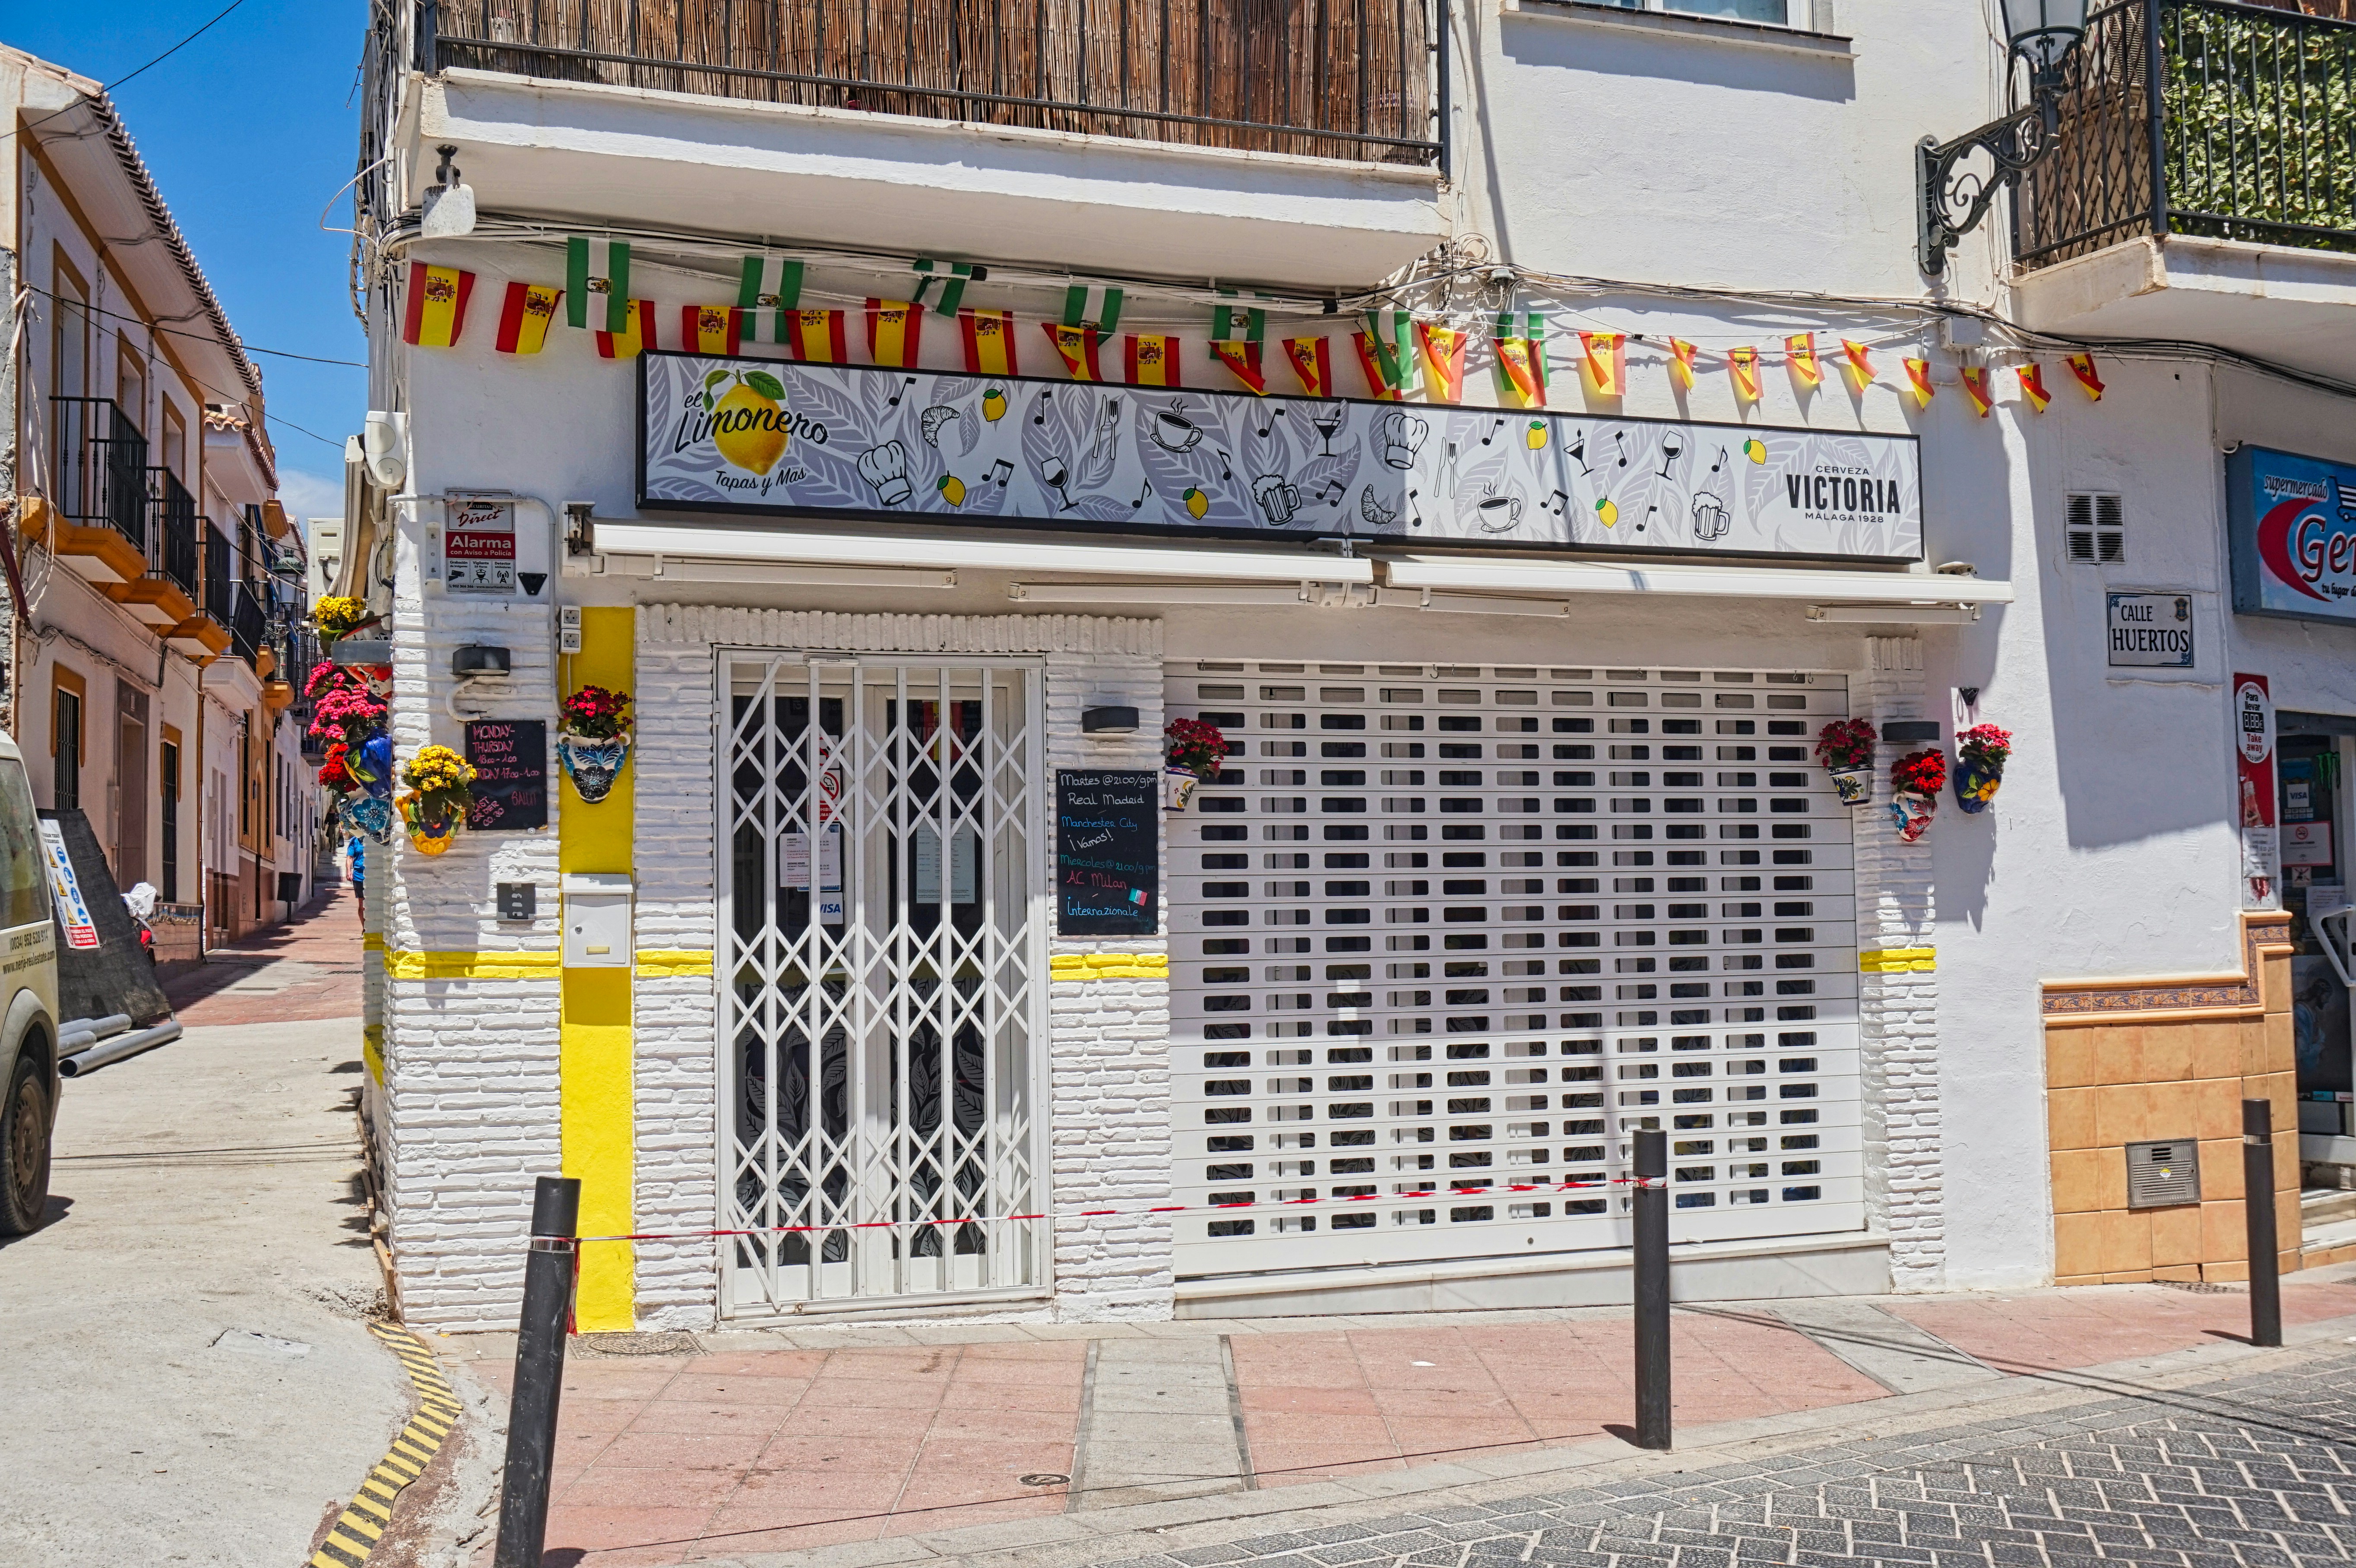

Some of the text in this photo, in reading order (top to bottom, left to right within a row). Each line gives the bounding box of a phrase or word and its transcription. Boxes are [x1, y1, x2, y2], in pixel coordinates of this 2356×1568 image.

[684, 391, 703, 408] el
[674, 407, 829, 454] Limonero
[1815, 465, 1870, 475] CERVEZA
[716, 468, 807, 497] Tapas y Mas
[2264, 475, 2328, 499] supermercado
[1786, 474, 1901, 514] VICTORIA
[457, 509, 506, 527] Direct
[1805, 512, 1855, 522] MÁLAGA
[450, 535, 512, 549] Alarma
[2121, 605, 2153, 622] CALLE
[2112, 628, 2189, 652] HUERTOS
[2246, 692, 2258, 702] Para
[2245, 701, 2260, 711] llevar
[2247, 733, 2262, 743] Take
[472, 740, 514, 753] THURSDAY
[2247, 744, 2263, 753] away
[476, 768, 500, 780] RIDAY
[1060, 774, 1100, 786] Martes
[1067, 792, 1145, 806] Real Madrid
[1062, 816, 1137, 832] Manchester City
[1066, 870, 1127, 890] AC Milan
[10, 934, 24, 952] (0034)
[32, 930, 41, 945] 528
[3, 950, 55, 974] www.nerja-realestate.com
